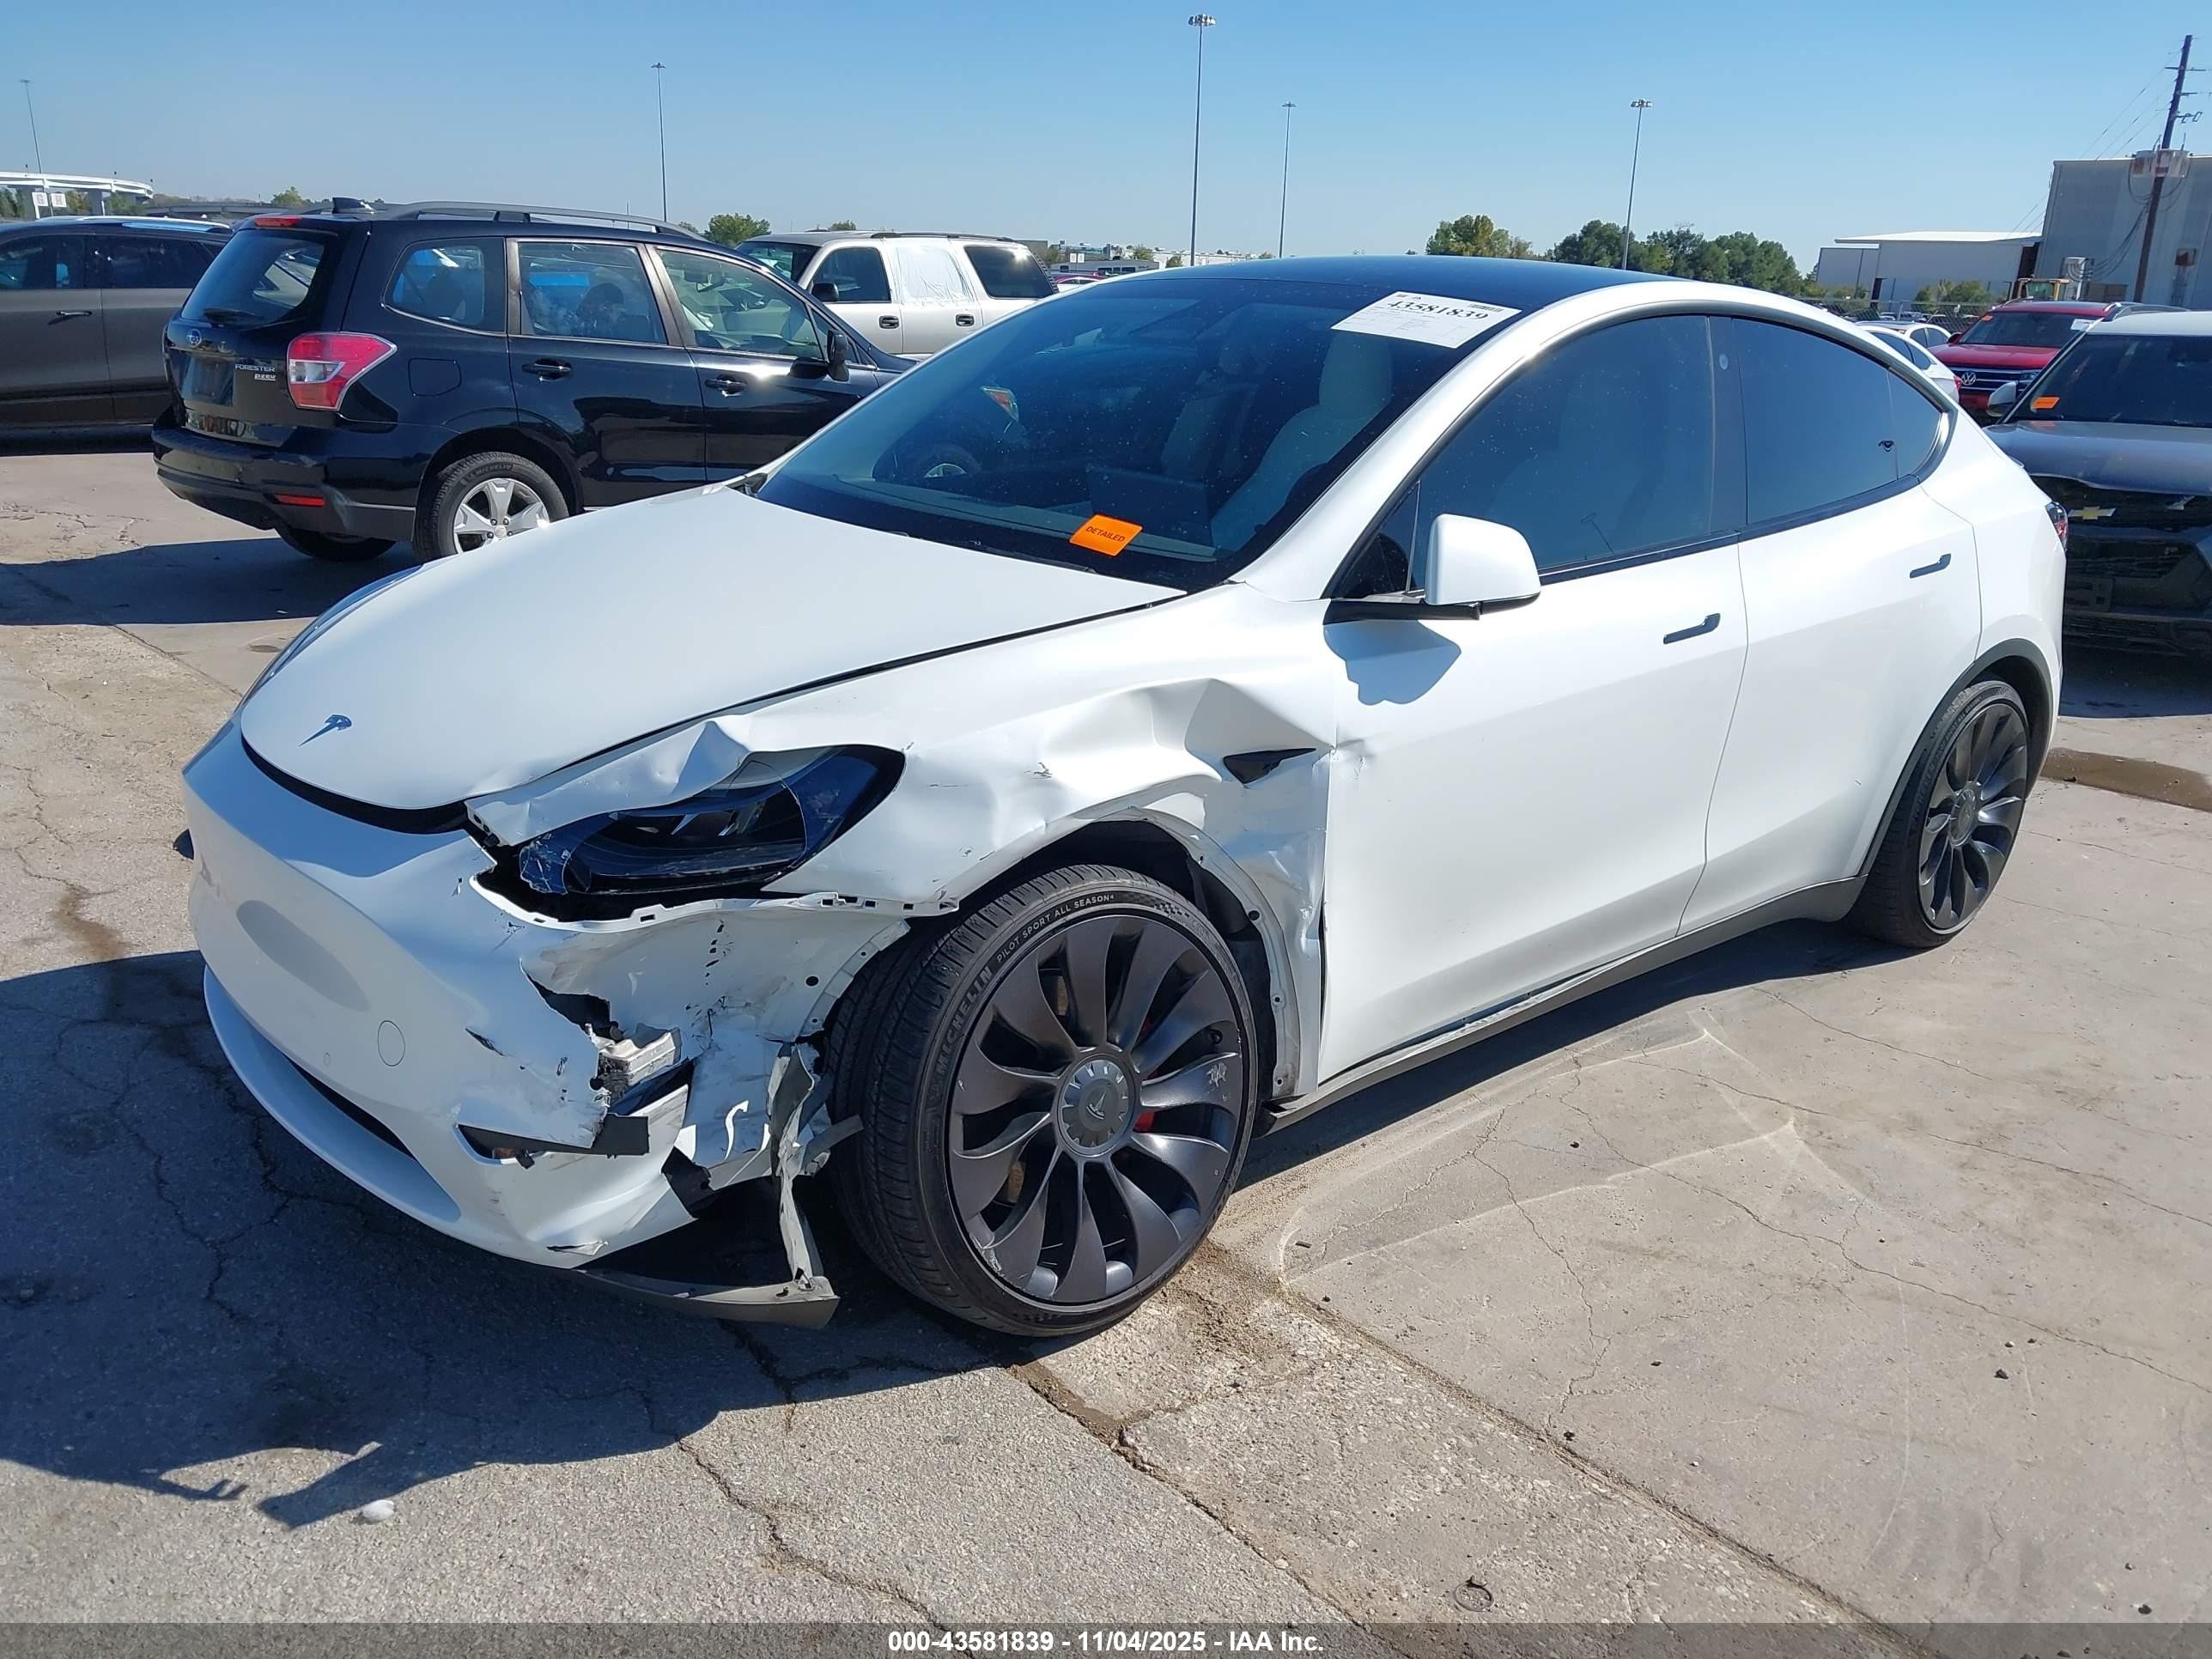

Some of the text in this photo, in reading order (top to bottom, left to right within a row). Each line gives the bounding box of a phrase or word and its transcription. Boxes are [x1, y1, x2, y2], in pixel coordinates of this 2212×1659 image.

[1388, 301, 1489, 319] 43581839
[234, 363, 276, 373] FORESTER
[1085, 526, 1126, 542] DETAILED
[996, 936, 1020, 963] PILOT
[1022, 914, 1051, 938] SPORT
[1054, 903, 1073, 917] ALL
[936, 965, 994, 1075] MICHELIN
